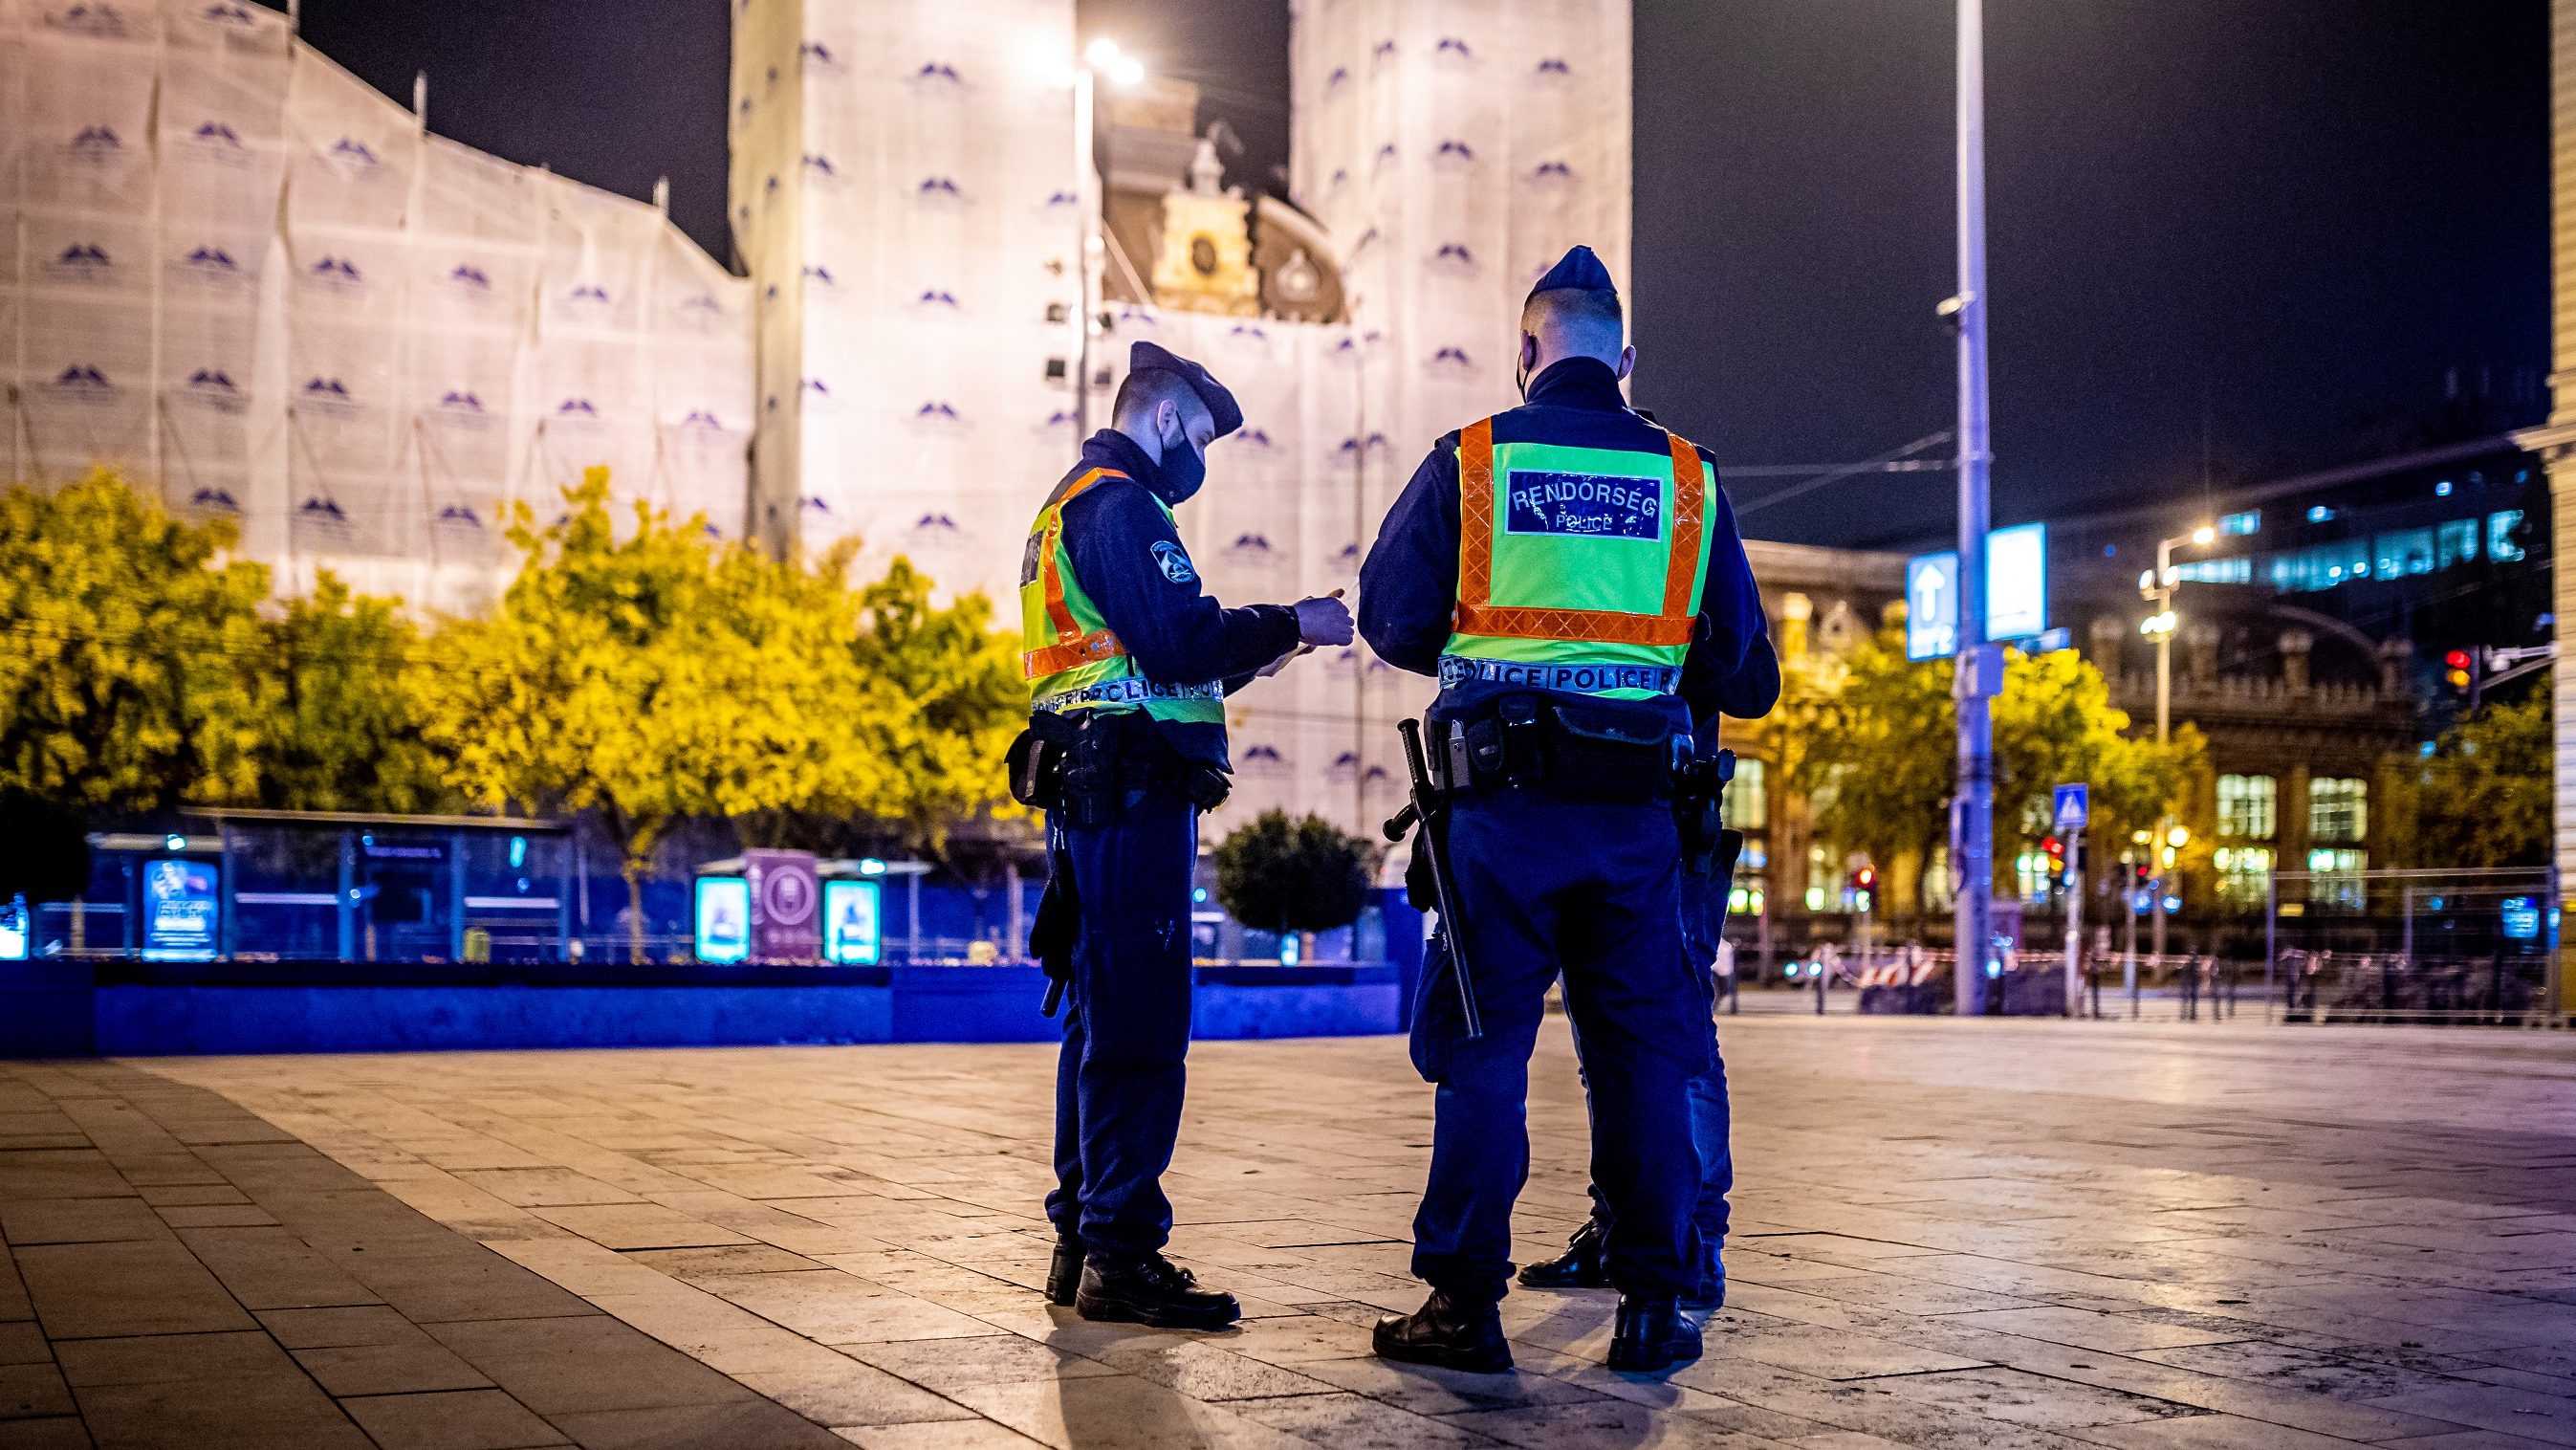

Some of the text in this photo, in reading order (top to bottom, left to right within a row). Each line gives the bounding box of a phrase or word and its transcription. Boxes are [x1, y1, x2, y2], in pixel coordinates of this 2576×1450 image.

[1512, 477, 1659, 518] RENDŐRSÉG
[1556, 514, 1612, 531] POLICE
[1555, 669, 1650, 689] POLICE
